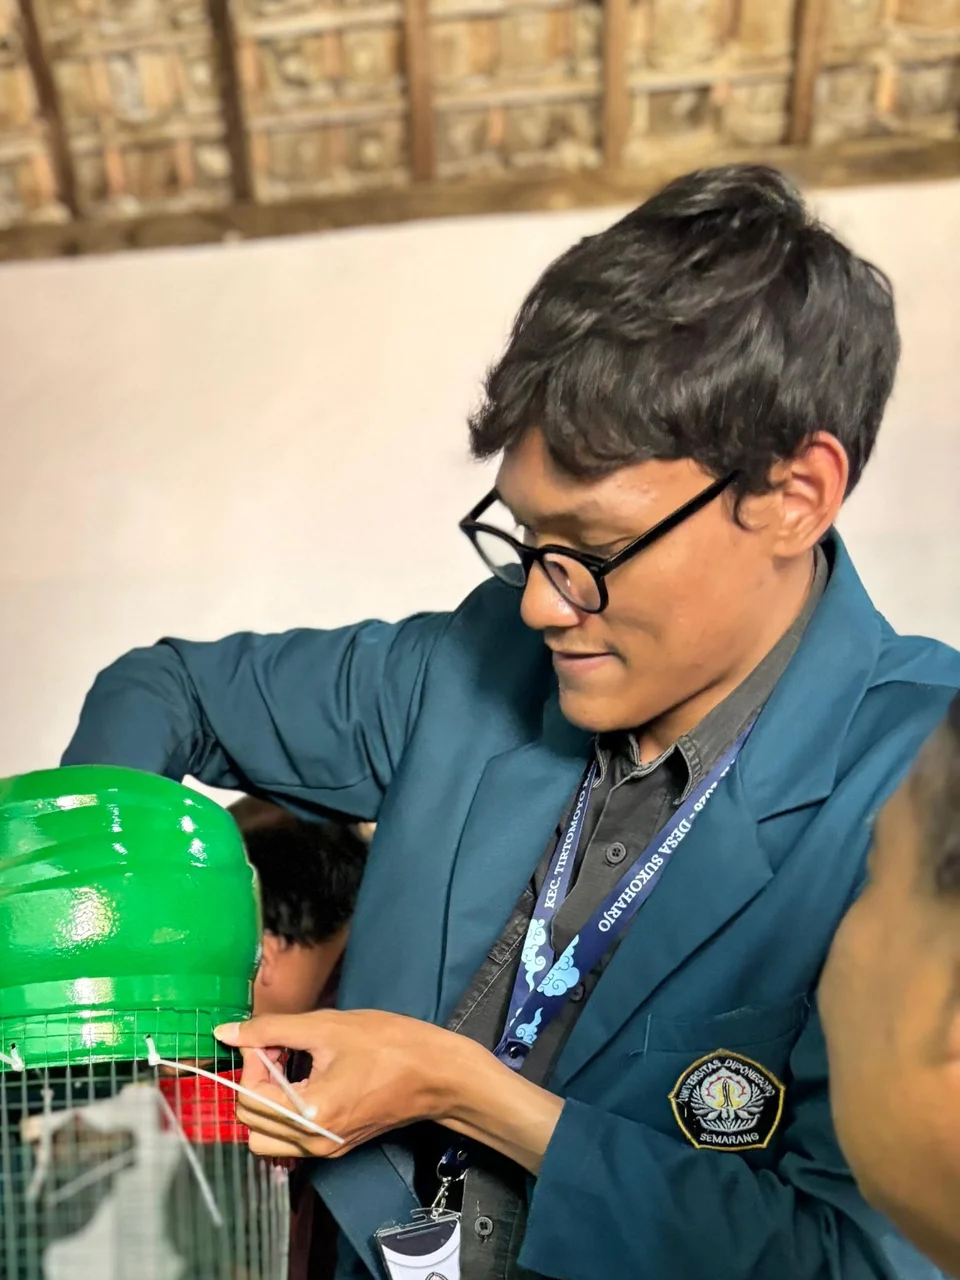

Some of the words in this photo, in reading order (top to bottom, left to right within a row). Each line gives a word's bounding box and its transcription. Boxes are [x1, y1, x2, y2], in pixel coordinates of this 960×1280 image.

[544, 876, 561, 909] KEC.
[554, 790, 586, 875] TIRTOMOYO
[657, 818, 692, 855] DESA
[597, 853, 664, 932] SUKOHARJO
[678, 1059, 721, 1102] UNIVERSITAS
[724, 1059, 776, 1097] DIPONEGORO
[699, 1132, 760, 1145] SEMARANG
